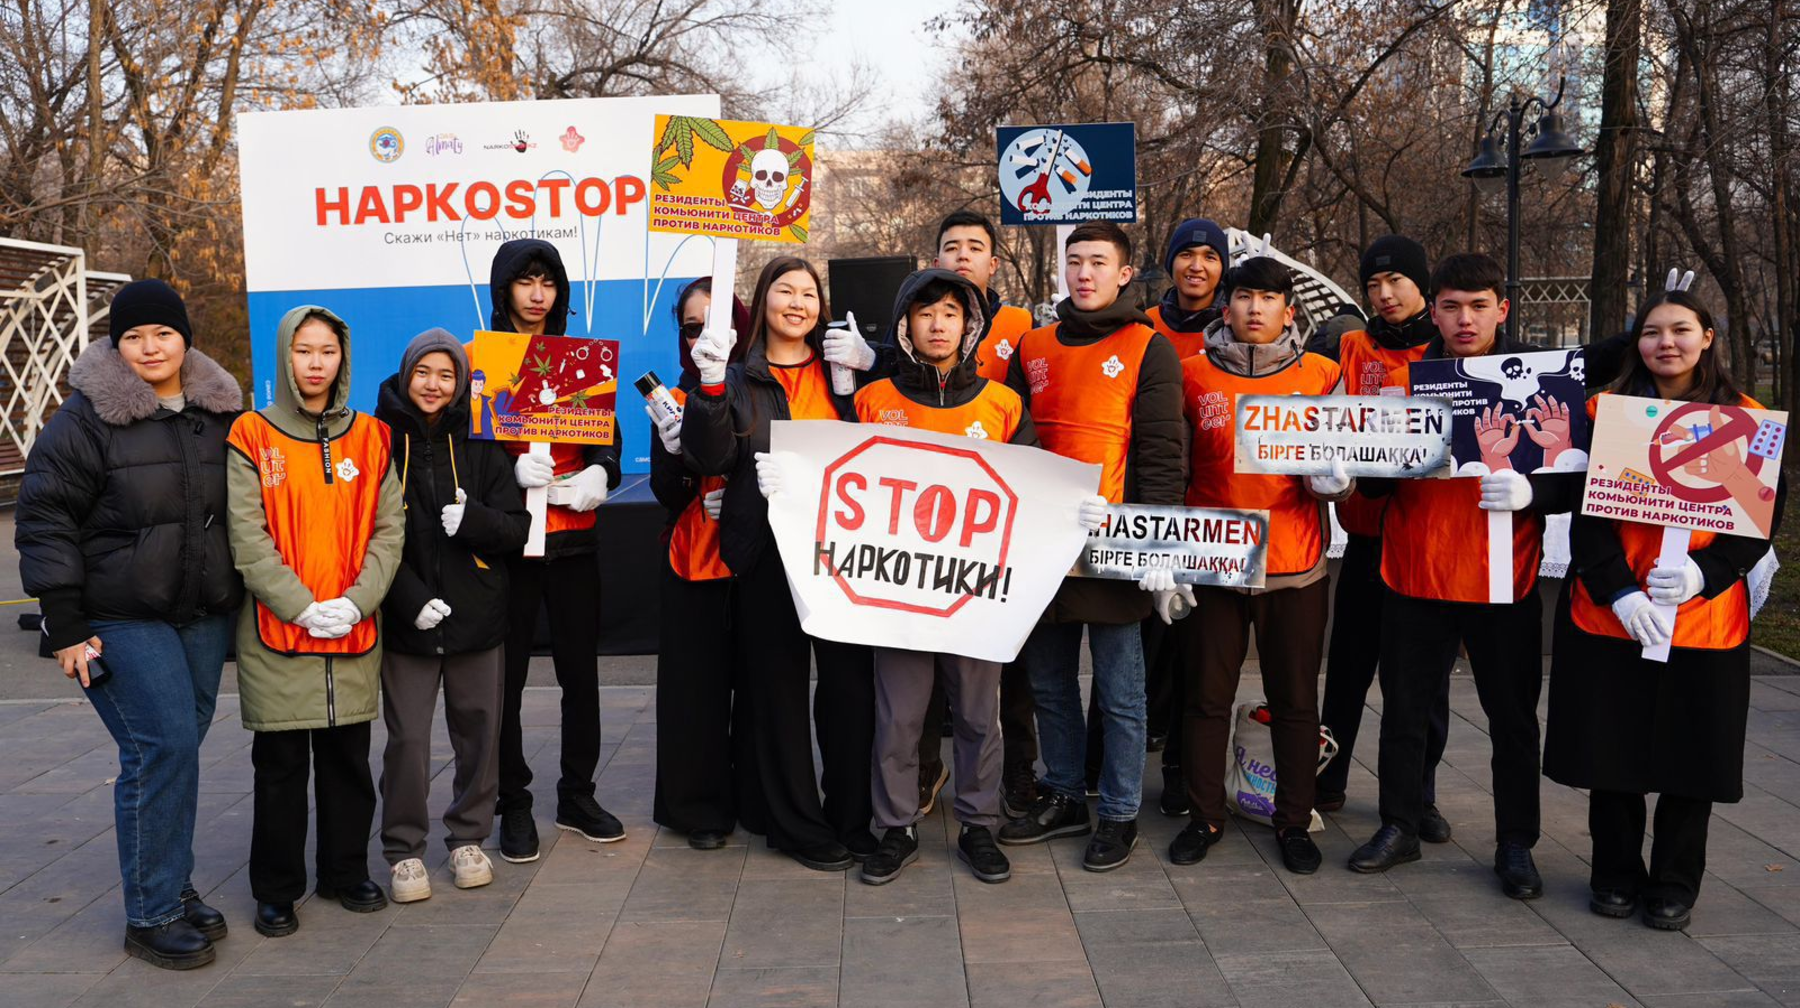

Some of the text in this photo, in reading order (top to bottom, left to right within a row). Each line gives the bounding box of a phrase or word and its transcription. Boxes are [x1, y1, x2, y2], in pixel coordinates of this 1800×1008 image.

[315, 176, 646, 226] НАРКОSTOP
[655, 194, 726, 207] РЕЗИДЕНТЫ
[1093, 201, 1133, 209] ЦЕНТРА
[654, 206, 780, 224] КОМЬЮНИТИ ЦЕНТРА
[1065, 212, 1133, 220] НАРКОТИКОВ
[384, 226, 577, 244] Скажи «Нет» наркотикам!
[653, 218, 781, 236] ПРОТИВ НАРКОТИКОВ
[1361, 361, 1386, 374] VOL
[1413, 382, 1468, 391] РЕЗИДЕНТЫ
[1198, 391, 1228, 406] VOL
[1452, 398, 1488, 407] ПРОТИВ
[548, 407, 611, 417] РЕЗИДЕНТЫ
[879, 409, 908, 422] VOL
[1244, 406, 1443, 435] ZHASTARMEN
[498, 415, 610, 428] КОМЬЮНИТИ ЦЕНТРА
[495, 426, 610, 439] ПРОТИВ НАРКОТИКОВ
[322, 437, 332, 474] FASHION
[1258, 444, 1305, 460] БІРГЕ
[1590, 478, 1672, 495] РЕЗИДЕНТЫ
[834, 472, 1001, 548] STOP
[1588, 490, 1733, 517] КОМЬЮНИТИ ЦЕНТРА
[1586, 503, 1735, 530] ПРОТИВ НАРКОТИКОВ
[1088, 513, 1261, 546] HASTARMEN
[1089, 549, 1133, 566] БІРГЕ
[814, 541, 1012, 603] НАРКОТИКИ!
